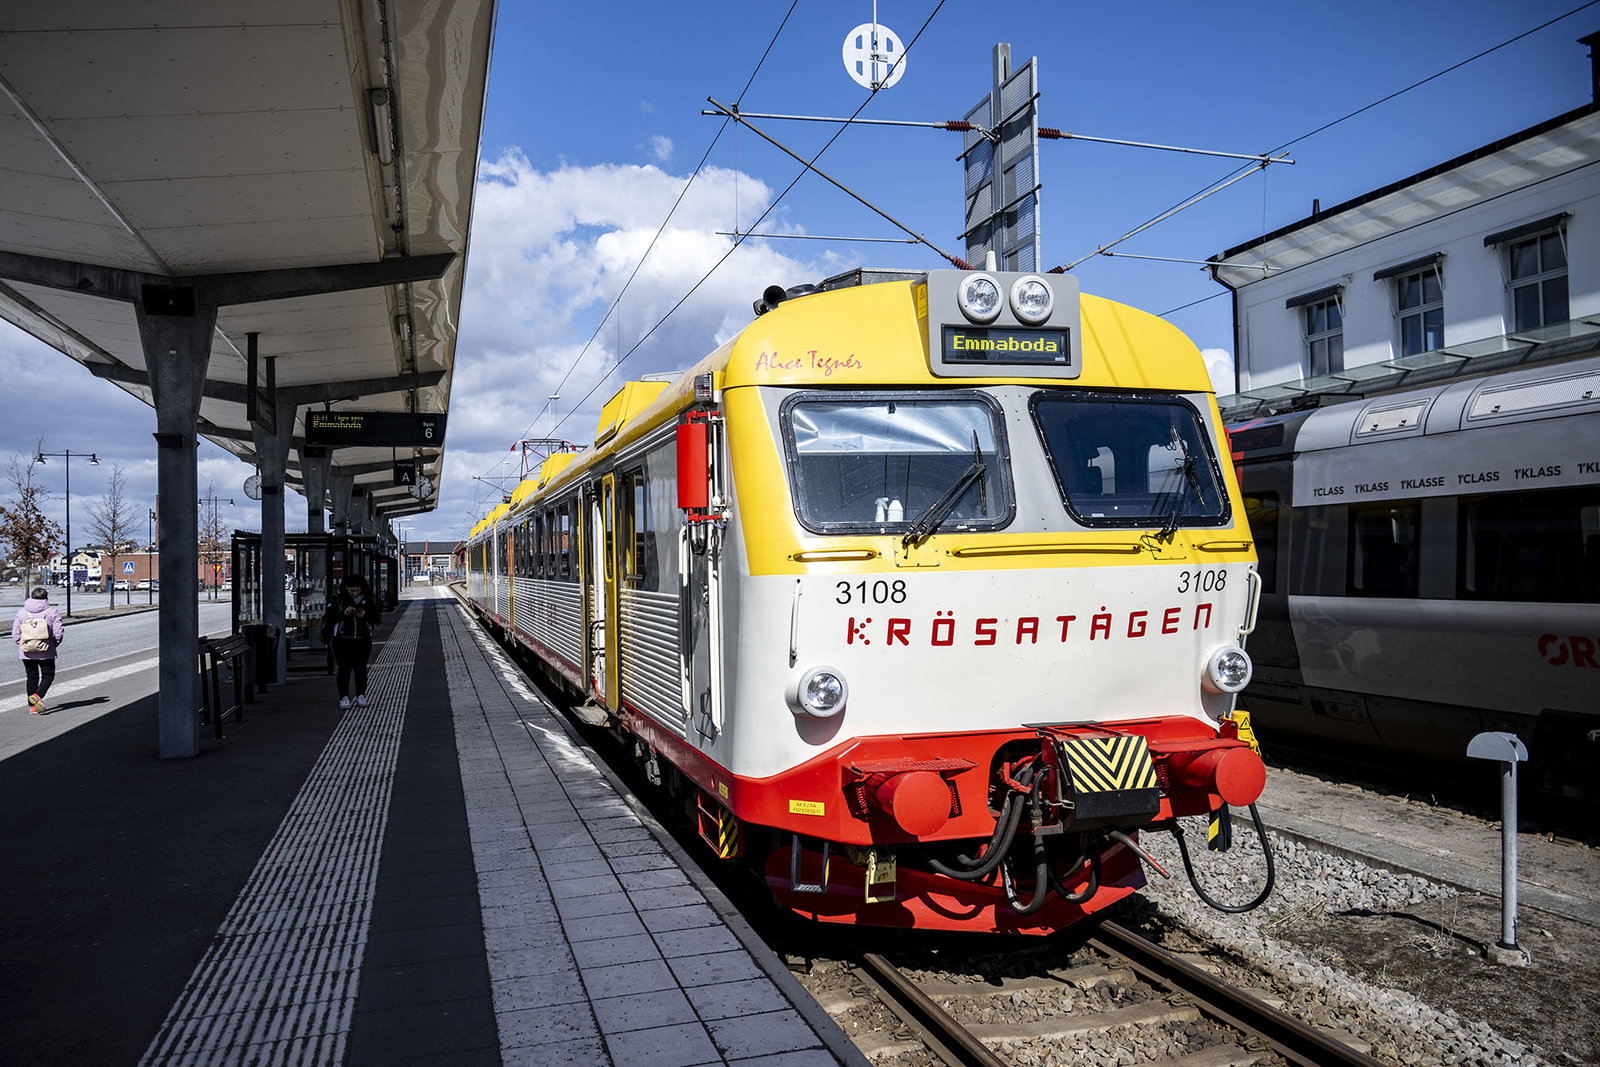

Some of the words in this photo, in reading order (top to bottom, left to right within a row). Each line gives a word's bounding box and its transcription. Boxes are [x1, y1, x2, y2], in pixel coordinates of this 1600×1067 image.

[953, 335, 1058, 352] Emmaboda
[755, 351, 803, 371] Alice
[807, 350, 863, 377] Tegnér
[425, 428, 433, 438] 6
[401, 472, 411, 482] A
[835, 580, 907, 605] 3108
[1177, 569, 1227, 595] 3108
[846, 602, 1213, 647] KRÖSATÅGEN
